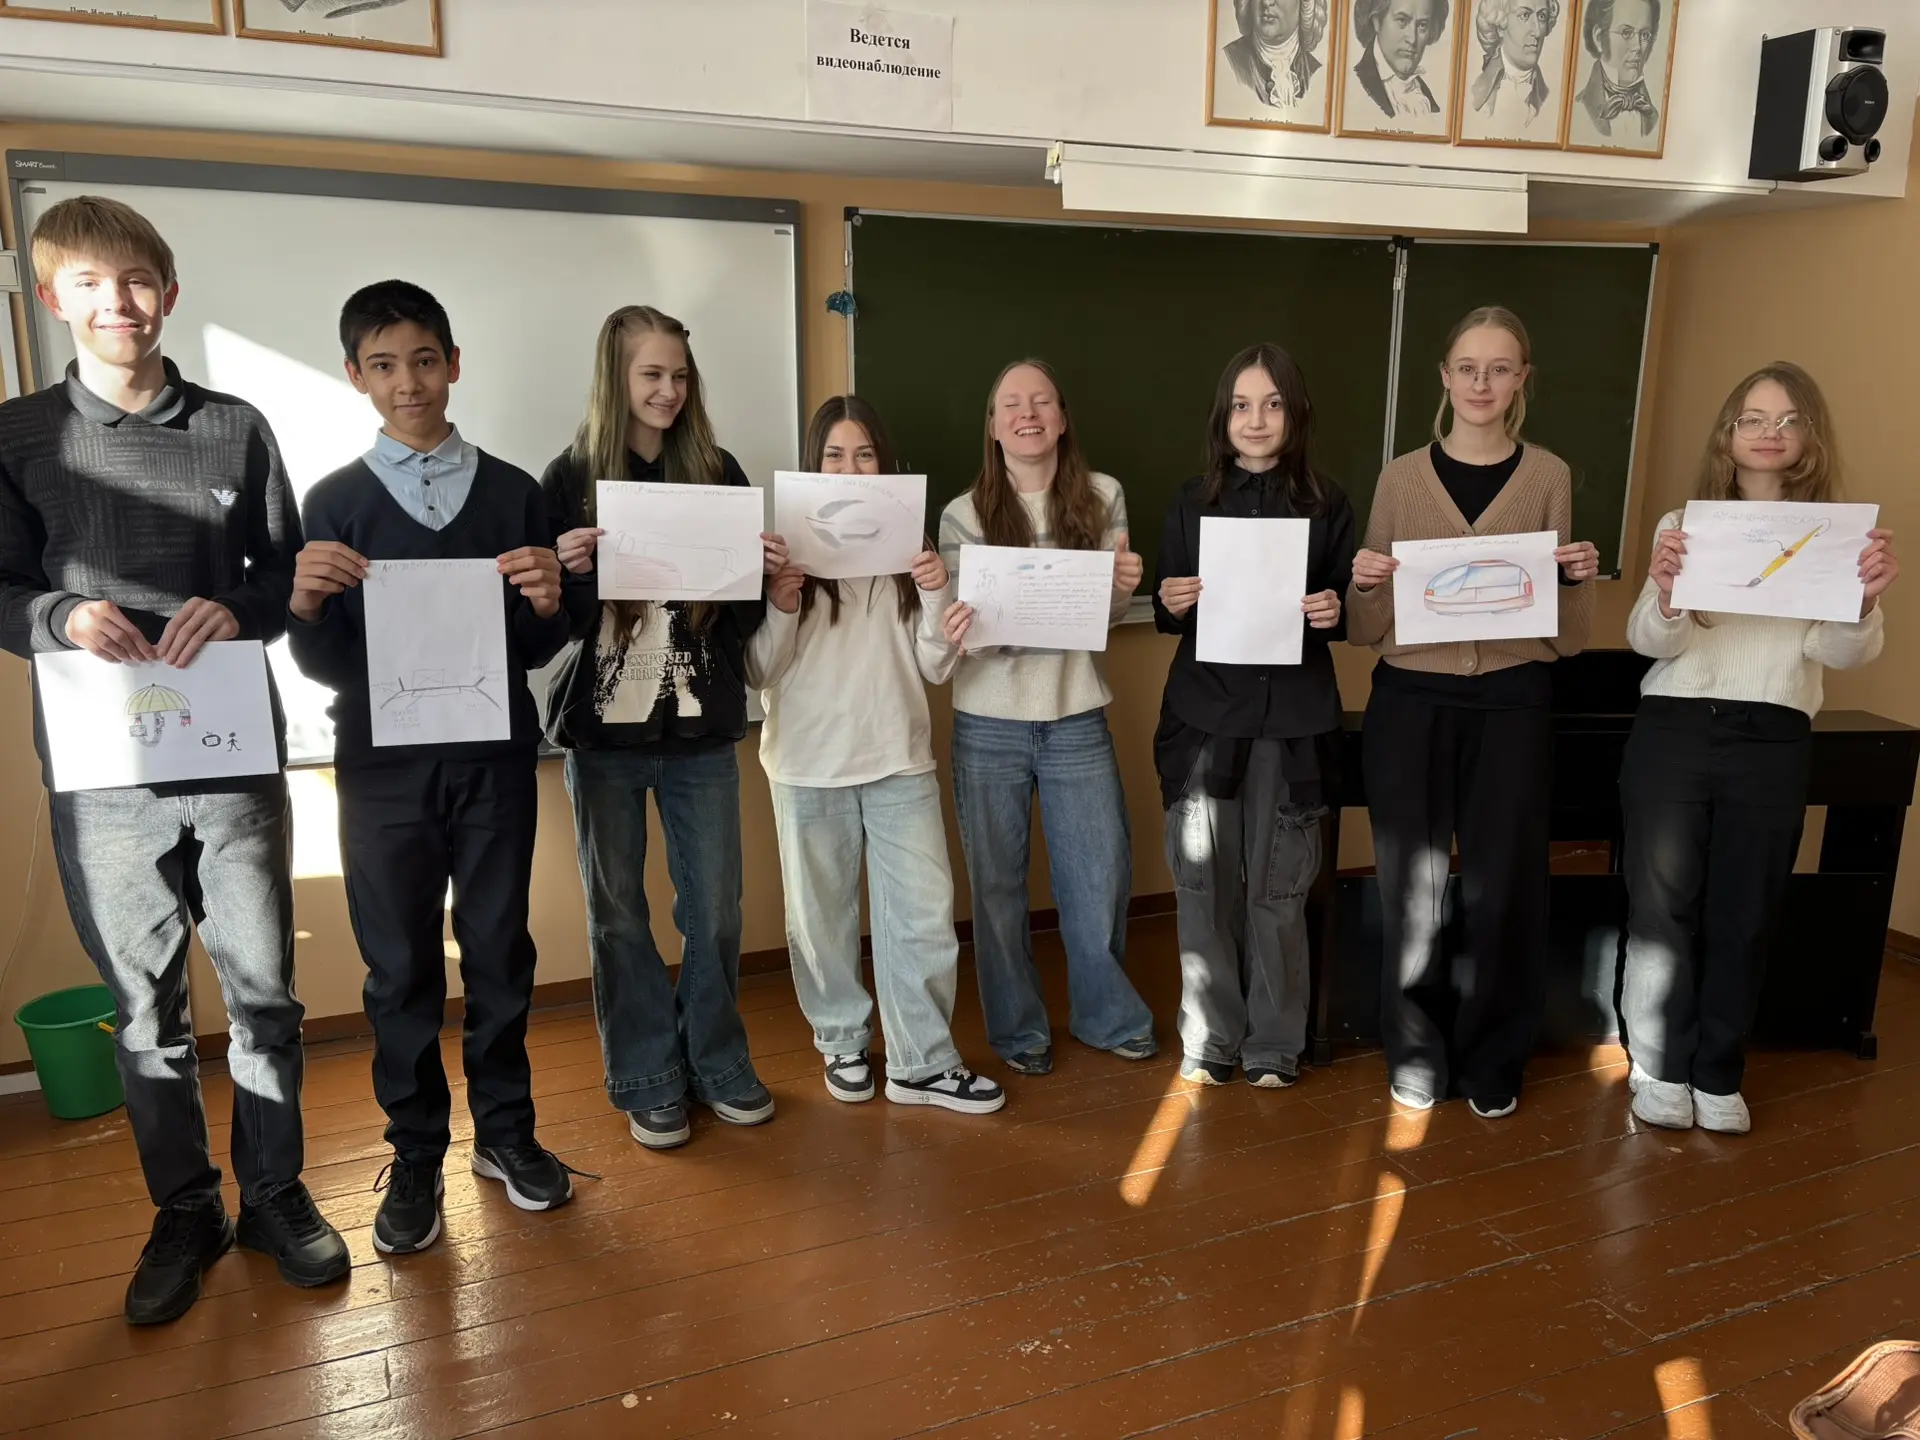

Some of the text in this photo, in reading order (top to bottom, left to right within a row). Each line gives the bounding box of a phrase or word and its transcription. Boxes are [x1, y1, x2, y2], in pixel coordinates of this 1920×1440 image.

[849, 27, 911, 50] Ведется
[816, 55, 941, 79] видеонаблюдение
[14, 160, 38, 168] SMART
[148, 480, 186, 490] ARMANI
[626, 651, 692, 668] EXPOSED
[615, 664, 697, 682] CHRISTINA
